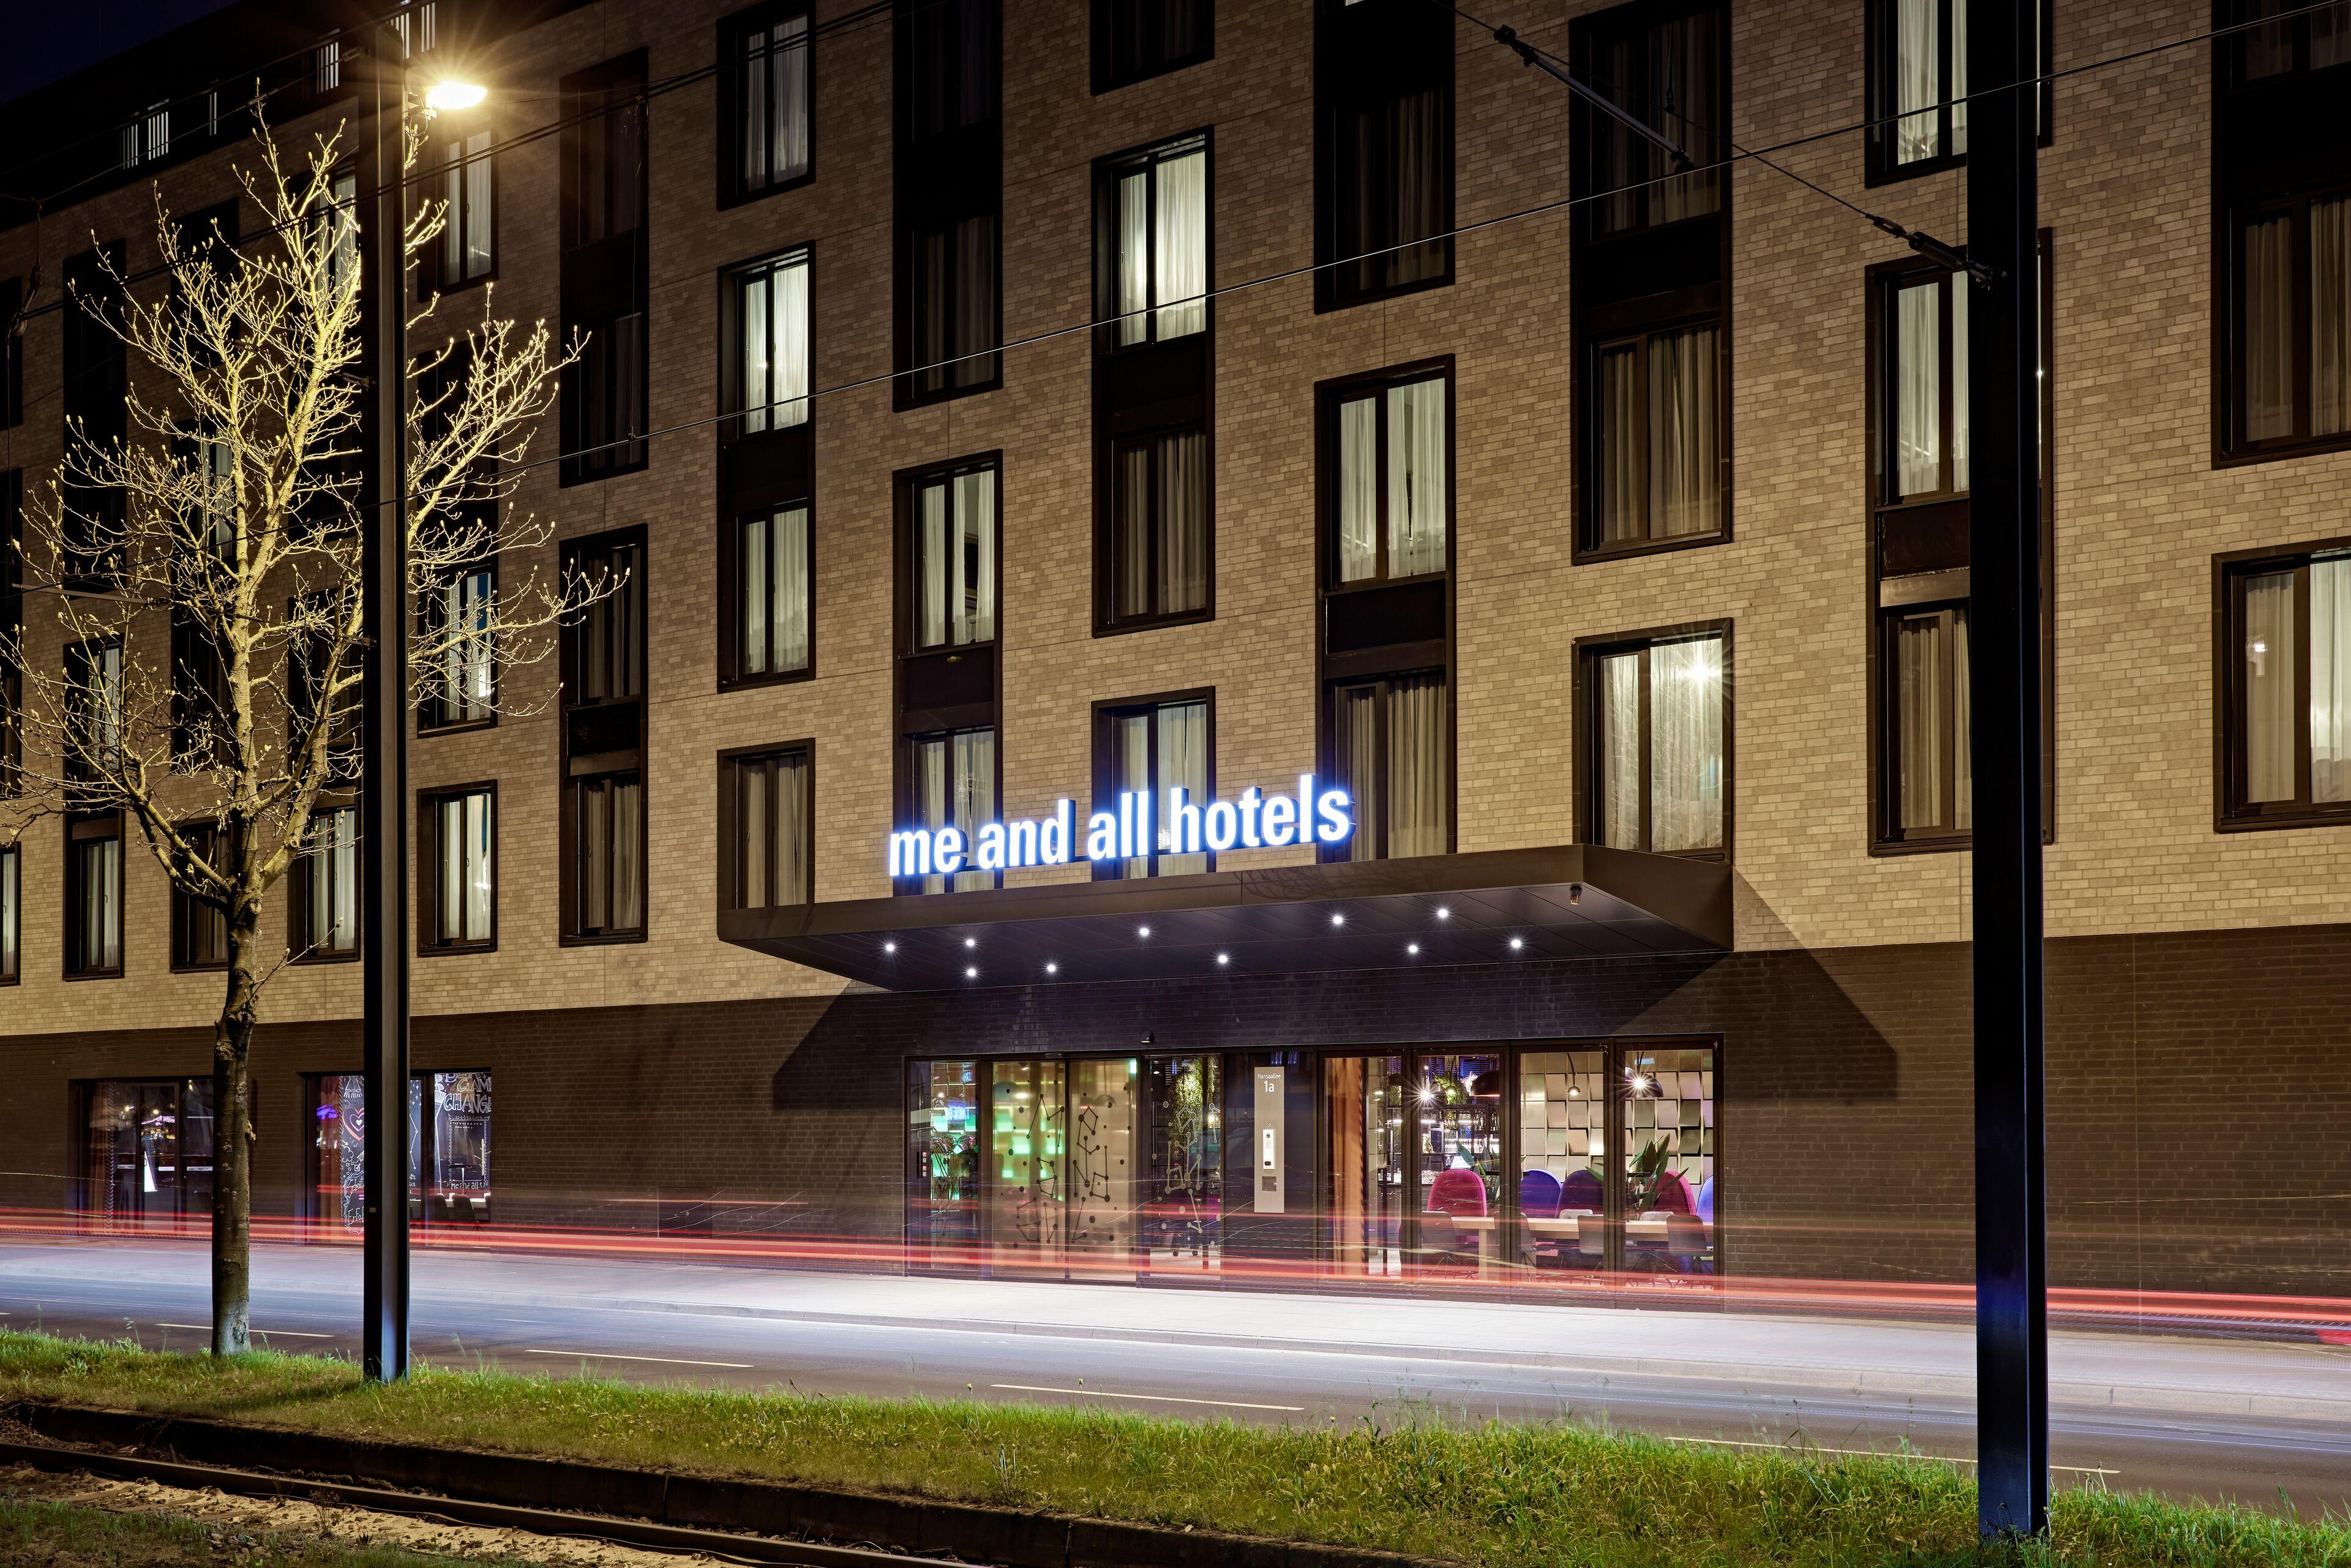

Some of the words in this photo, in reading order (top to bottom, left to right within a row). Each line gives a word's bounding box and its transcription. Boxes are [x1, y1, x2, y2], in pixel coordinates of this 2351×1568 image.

[890, 828, 966, 877] me
[978, 798, 1073, 869] and
[1087, 789, 1151, 861] all
[1171, 773, 1352, 853] hotels
[457, 1076, 492, 1093] GAM
[1264, 1080, 1275, 1092] 1a
[443, 1092, 492, 1114] CHANGE
